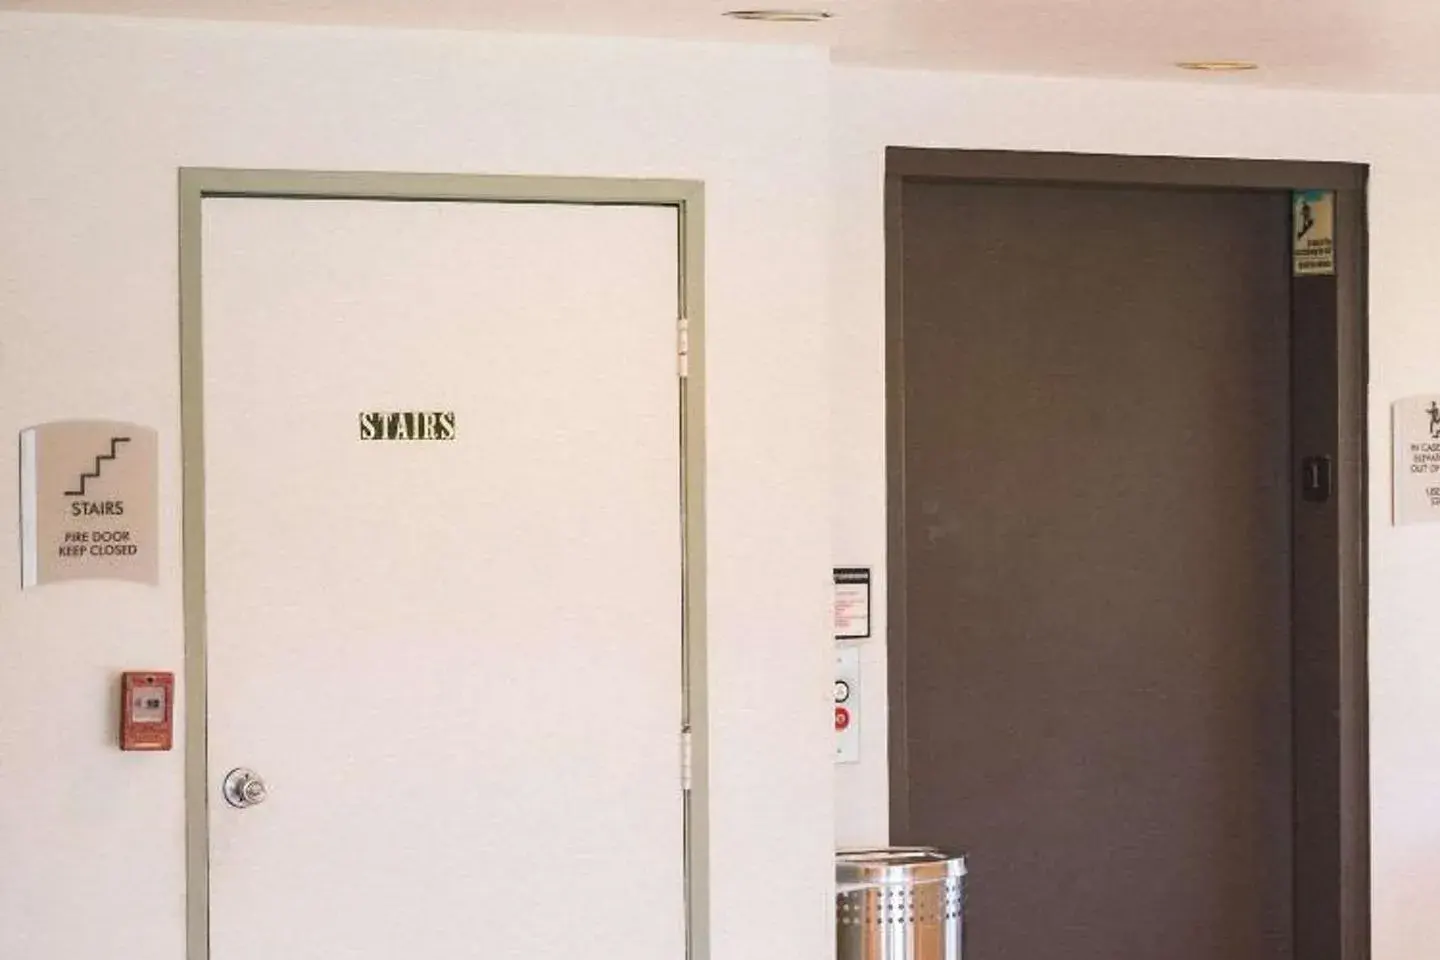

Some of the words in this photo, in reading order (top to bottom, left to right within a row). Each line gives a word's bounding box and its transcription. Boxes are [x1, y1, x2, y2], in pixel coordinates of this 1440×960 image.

[360, 411, 455, 440] STAIRS
[1410, 464, 1427, 473] OUT
[71, 501, 124, 517] STAIRS
[64, 531, 89, 542] FIRE
[92, 531, 130, 542] DOOR
[58, 545, 87, 557] KEEP
[89, 544, 137, 556] CLOSED
